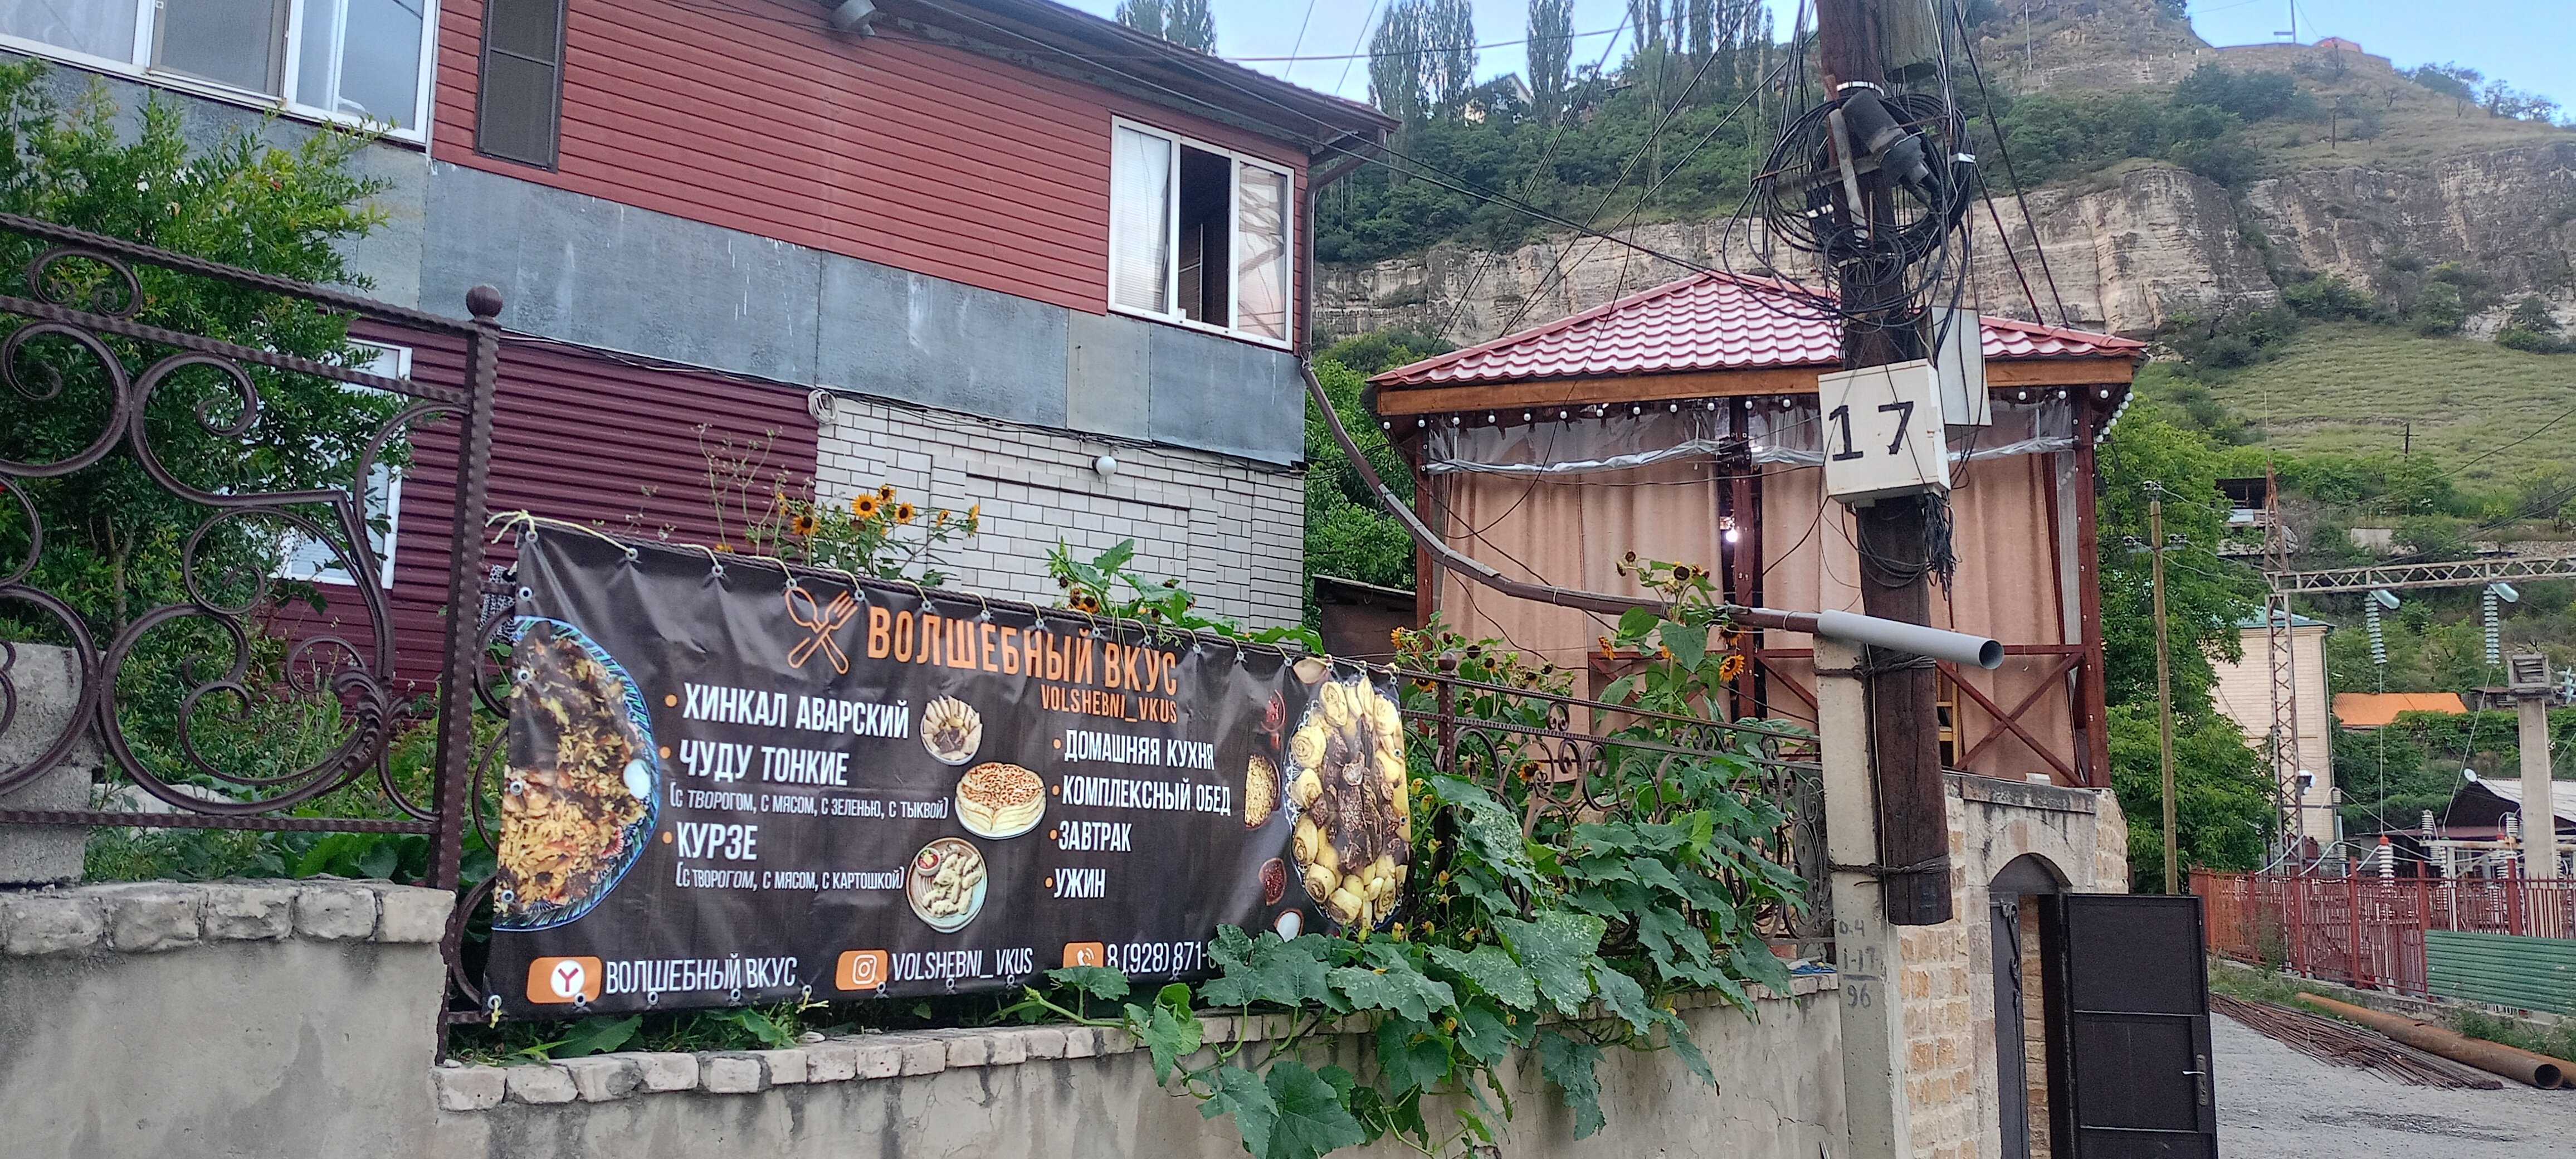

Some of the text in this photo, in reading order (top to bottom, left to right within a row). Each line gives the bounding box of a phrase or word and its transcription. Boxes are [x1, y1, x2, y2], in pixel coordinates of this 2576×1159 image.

[1828, 401, 1914, 462] 17
[867, 606, 1178, 695] ВОЛШЕБНЫЙ ВКУС
[682, 683, 910, 739] ХИНКАЛ АВАРСКИЙ
[1041, 684, 1177, 723] VOLSHEBNI_VKUS
[679, 739, 850, 786] ЧУДУ ТОНКИЕ
[1064, 729, 1215, 770] ДОМАШНЯЯ КУХНЯ
[670, 782, 948, 819] (С ТВОРОГОМ, С МЯСОМ, С ЗЕЛЕНЬЮ, С ТЫКВОЙ)
[1062, 775, 1231, 816] КОМПЛЕКСНЫЙ ОБЕД
[676, 822, 758, 860] КУРЗЕ
[1058, 820, 1131, 853] ЗАВТРАК
[676, 861, 904, 892] (С ТВОРОГОМ, С МЯСОМ, С КАРТОШКОЙ)
[1053, 868, 1106, 899] УЖИН
[606, 953, 798, 995] ВОЛШЕБНЫЙ ВКУС
[892, 947, 1033, 981] VOLSHEBNI_VKUS
[1108, 943, 1119, 968] 8
[1123, 942, 1169, 973] (928)
[1848, 983, 1871, 1009] 96
